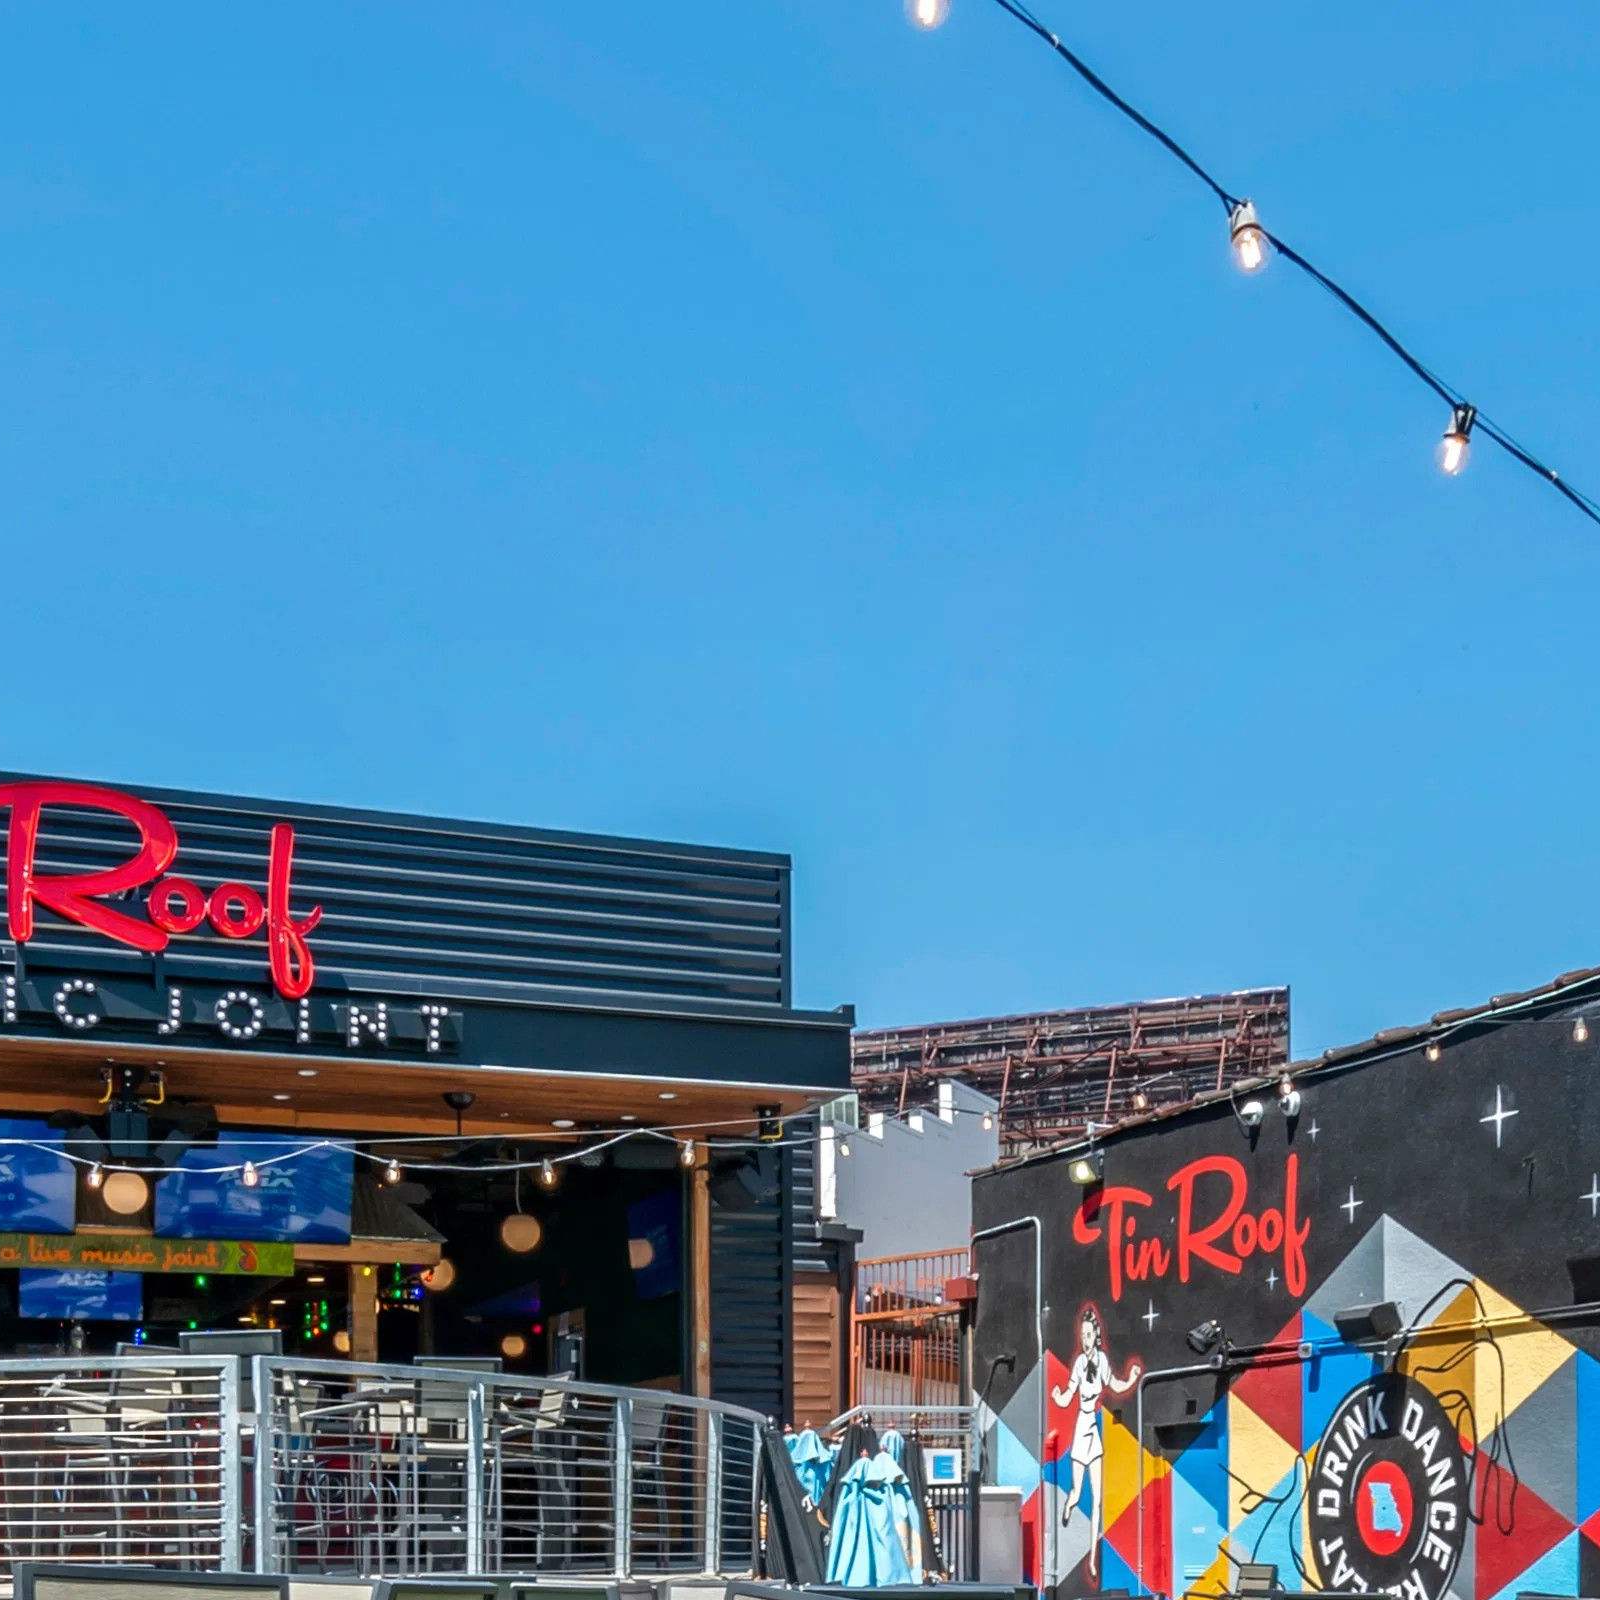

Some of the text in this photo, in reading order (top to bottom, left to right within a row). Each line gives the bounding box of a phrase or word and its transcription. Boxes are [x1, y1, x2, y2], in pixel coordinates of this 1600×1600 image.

[157, 986, 449, 1053] JOINT
[29, 1236, 72, 1263] live
[81, 1243, 156, 1265] music
[162, 1241, 219, 1271] joint
[1073, 1152, 1311, 1302] Tin Roof
[1317, 1391, 1389, 1518] DRINK
[1399, 1398, 1458, 1571] DANCE
